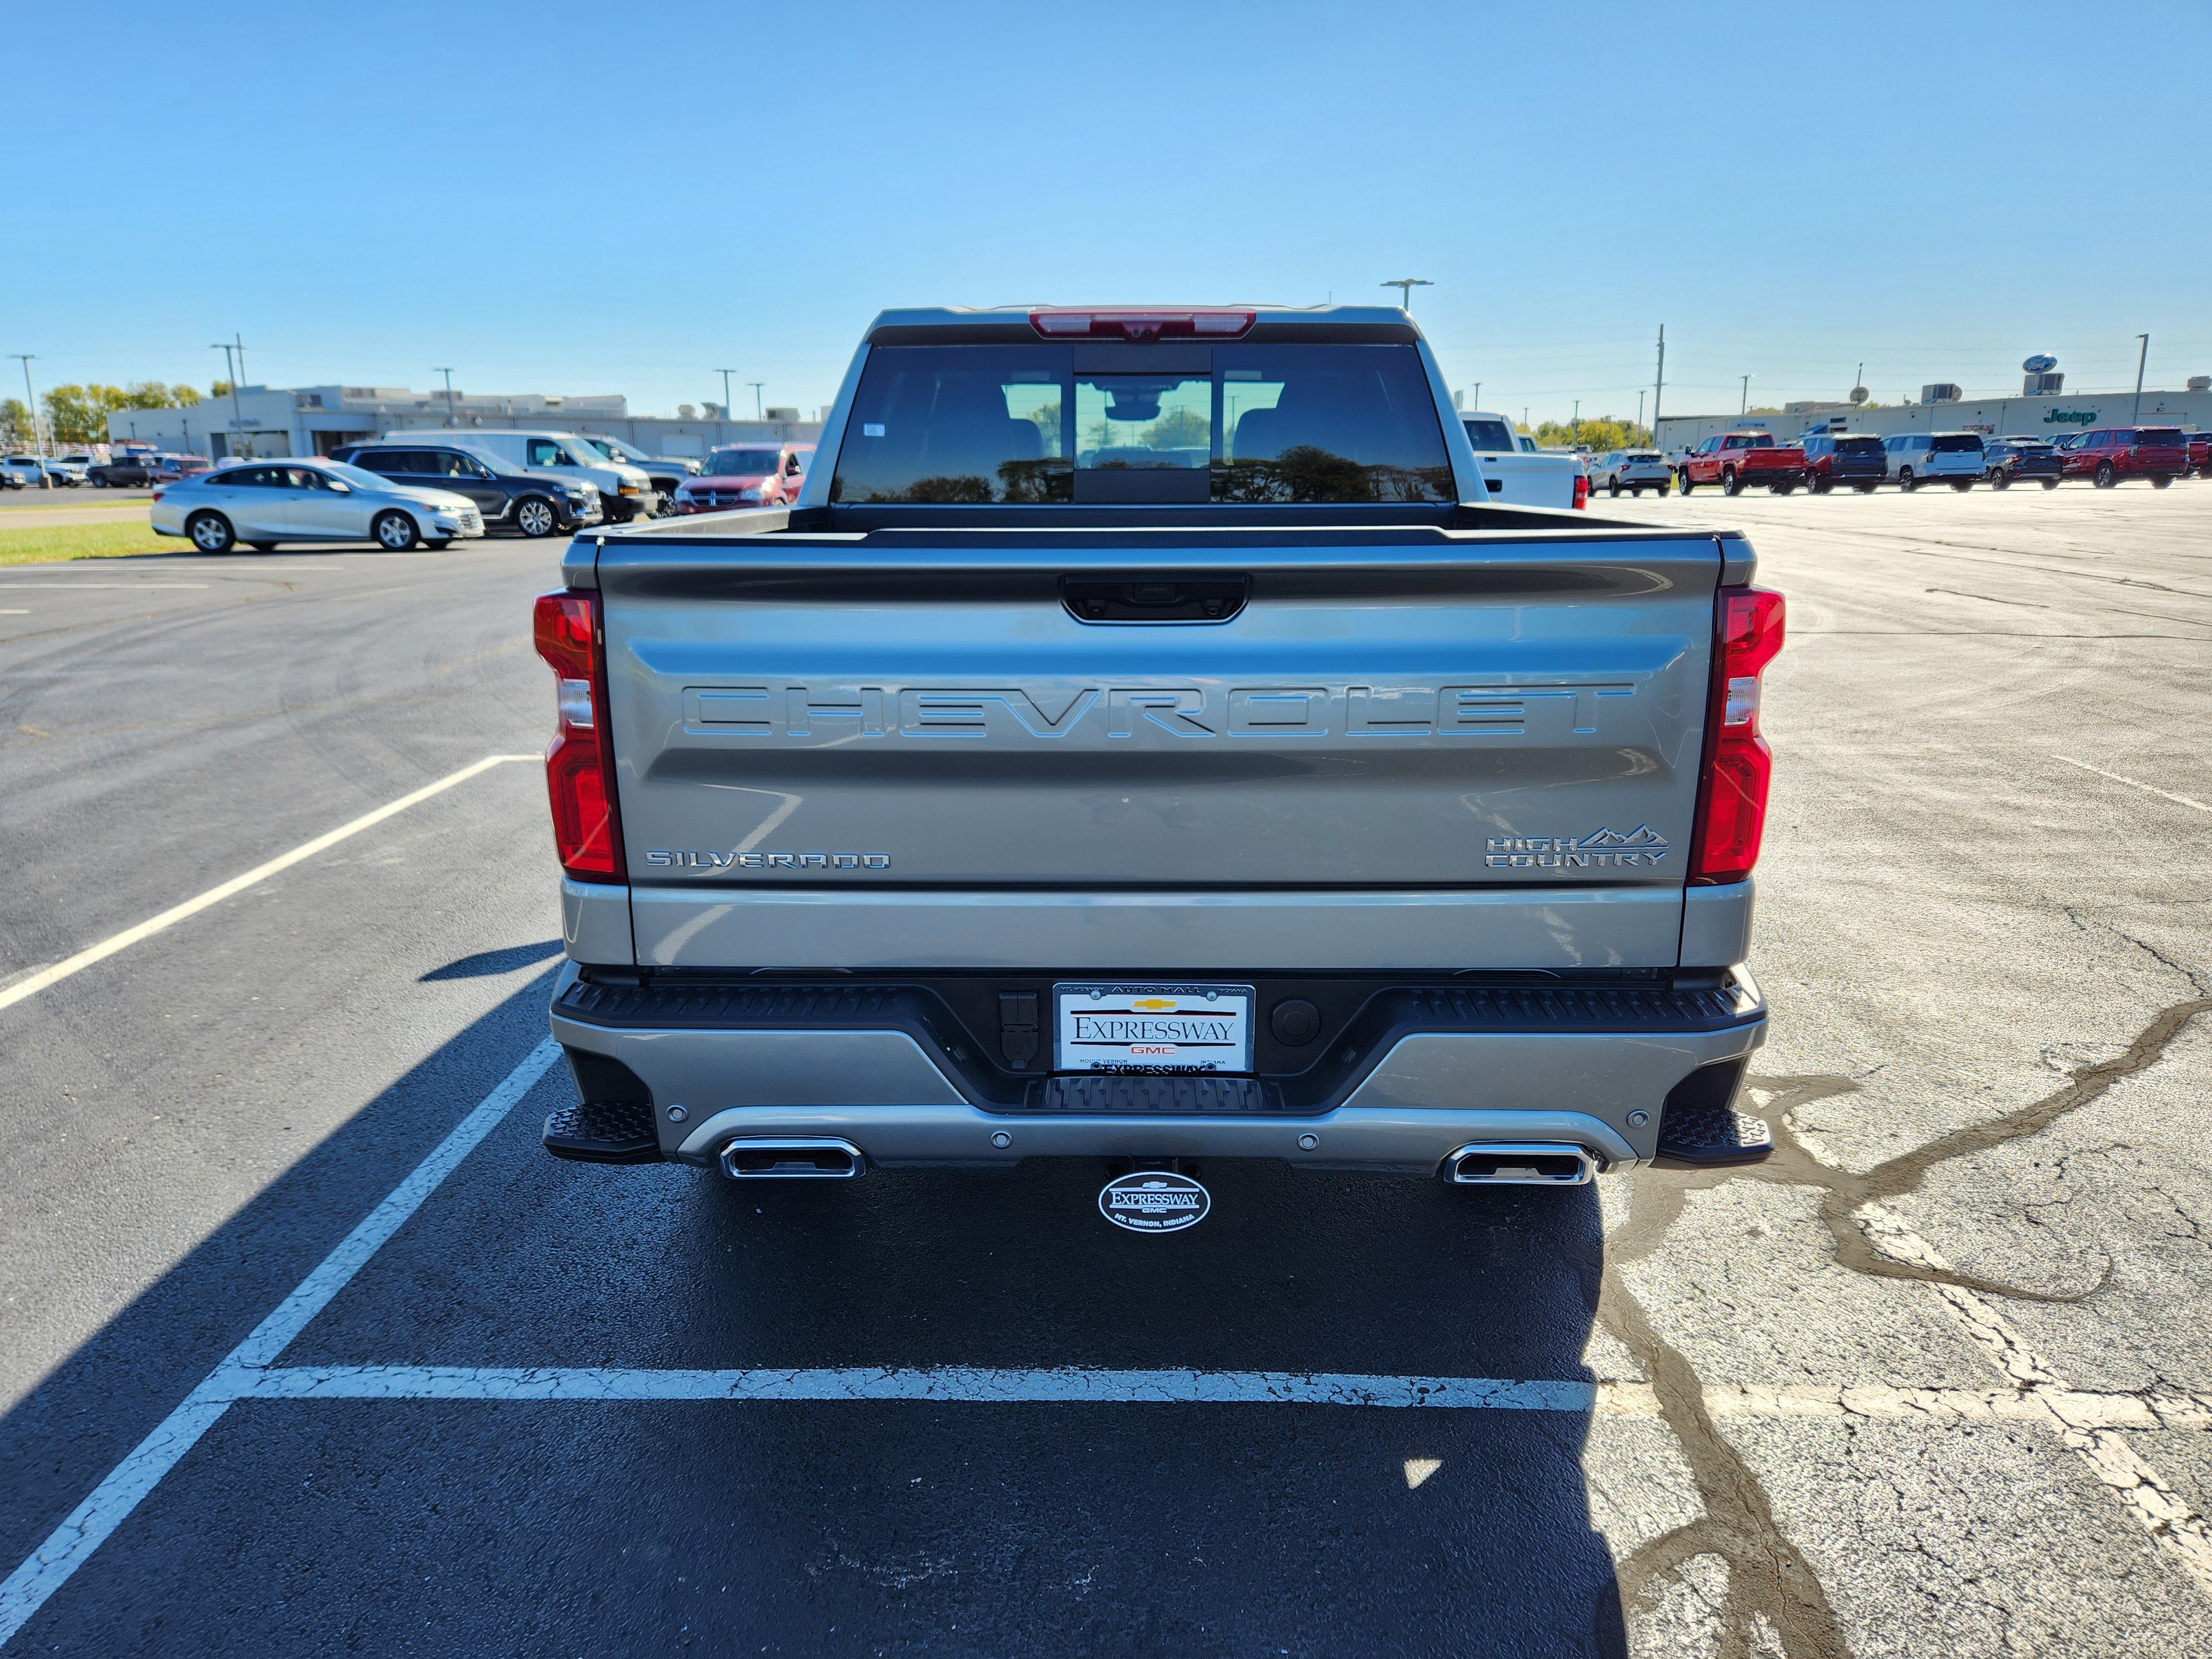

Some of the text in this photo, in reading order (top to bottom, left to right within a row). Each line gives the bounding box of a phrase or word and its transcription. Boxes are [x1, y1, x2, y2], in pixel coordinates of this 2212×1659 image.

[2043, 408, 2097, 426] Jeep
[682, 683, 1635, 737] CHEVROLET
[1486, 837, 1578, 852] HIGH
[645, 851, 891, 869] SILVERADO
[1485, 852, 1667, 867] COUNTRY
[1105, 1064, 1206, 1075] EXPRESSWAY
[1114, 1213, 1195, 1228] MT. VERNON, INDIANA
